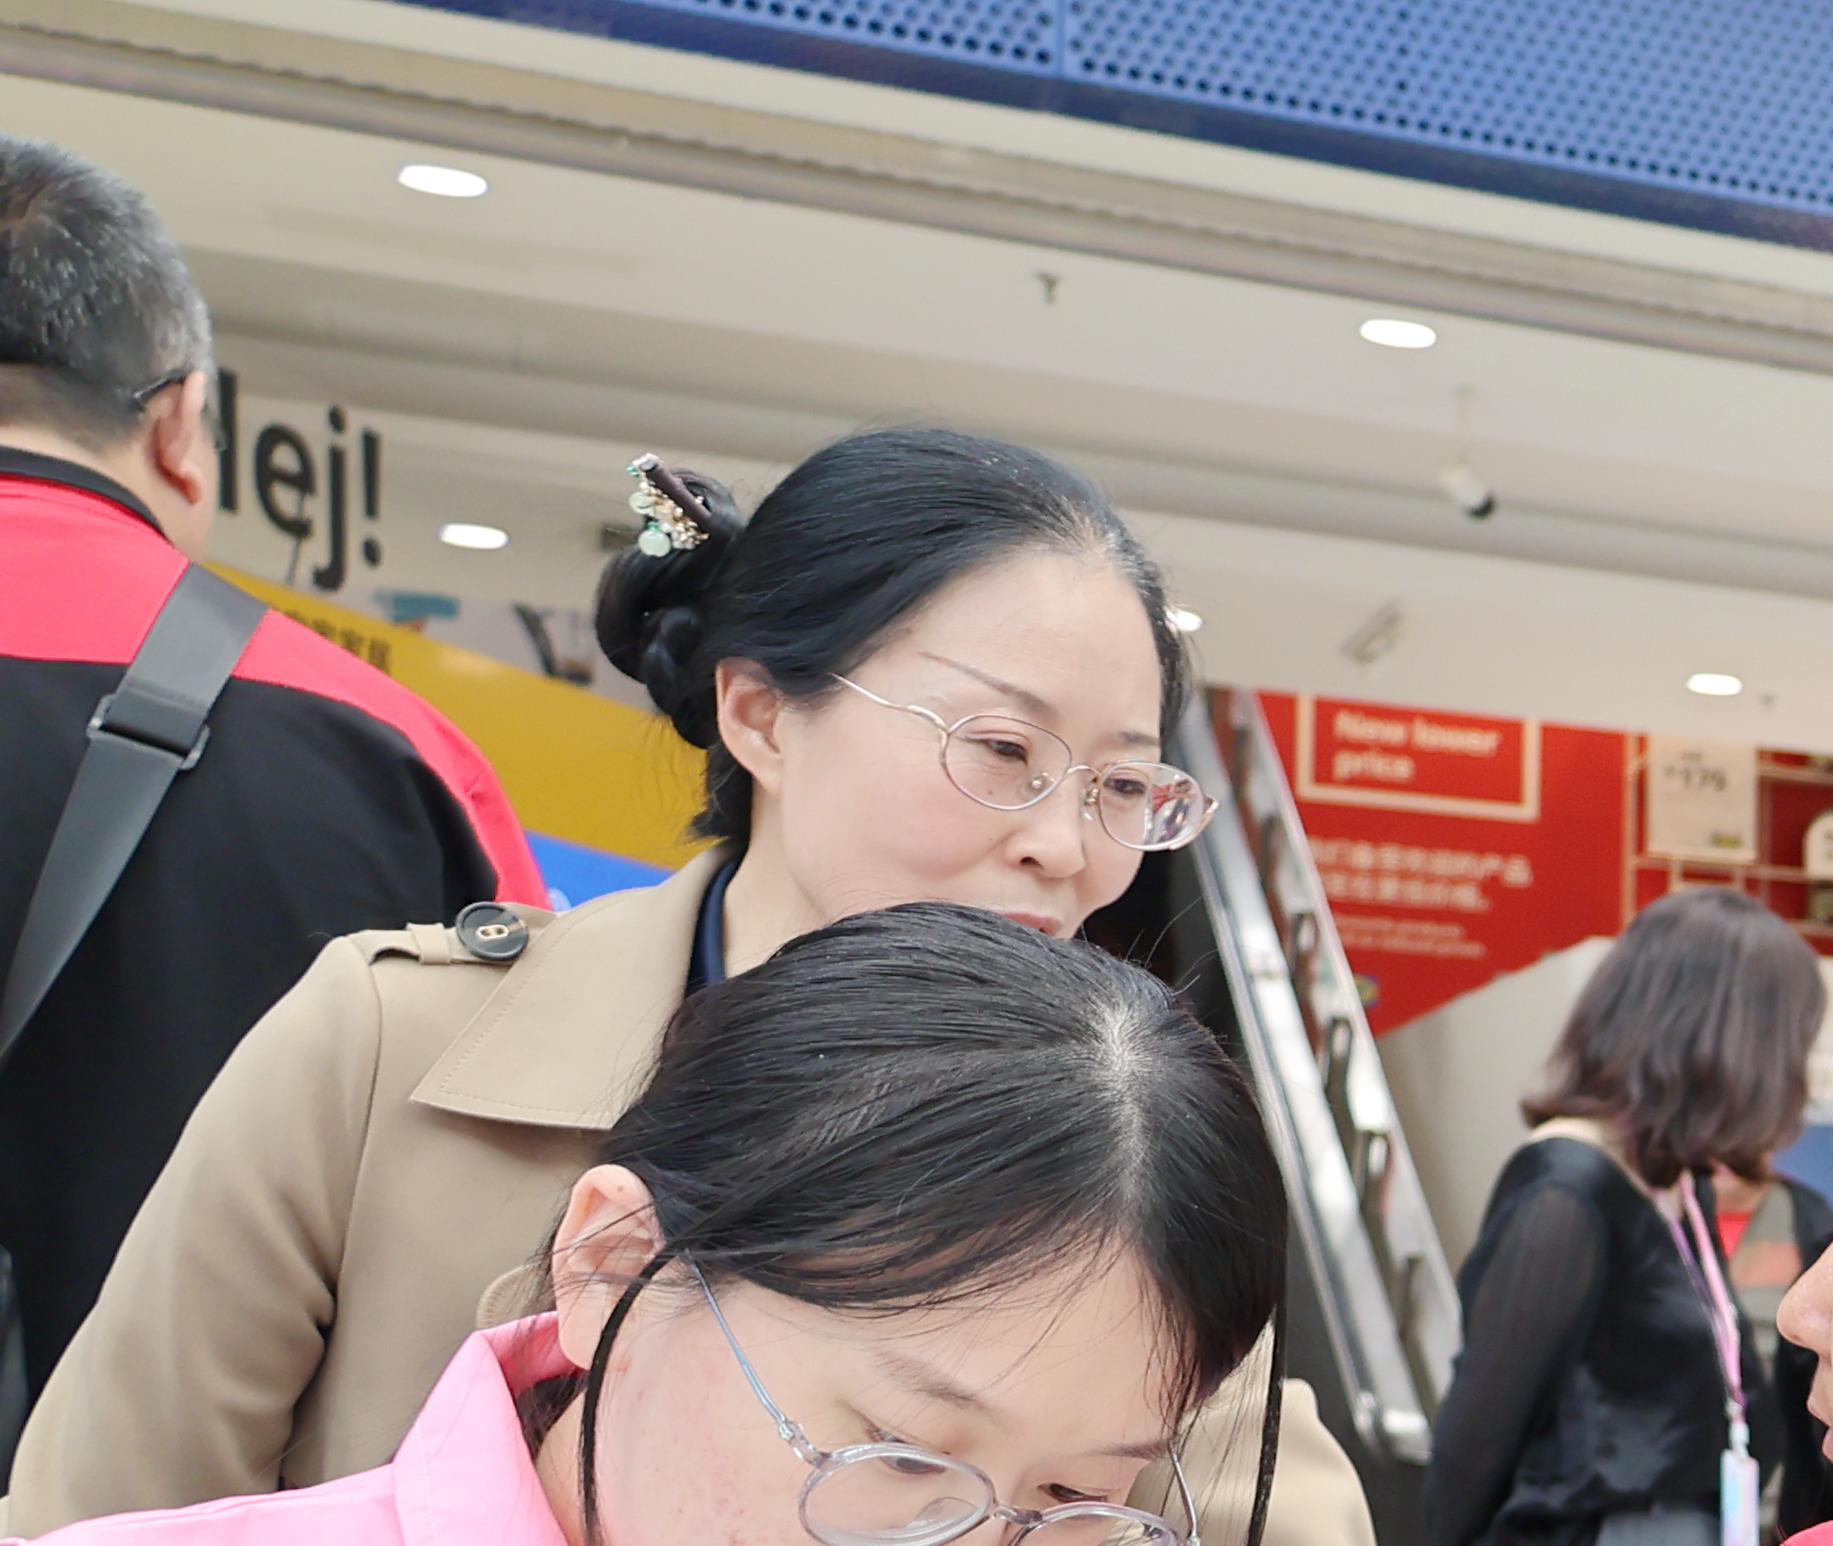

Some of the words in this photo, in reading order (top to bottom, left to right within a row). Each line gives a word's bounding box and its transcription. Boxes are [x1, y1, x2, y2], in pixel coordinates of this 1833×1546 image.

[1334, 710, 1406, 747] New
[1412, 715, 1500, 757] lower
[1333, 751, 1415, 783] price
